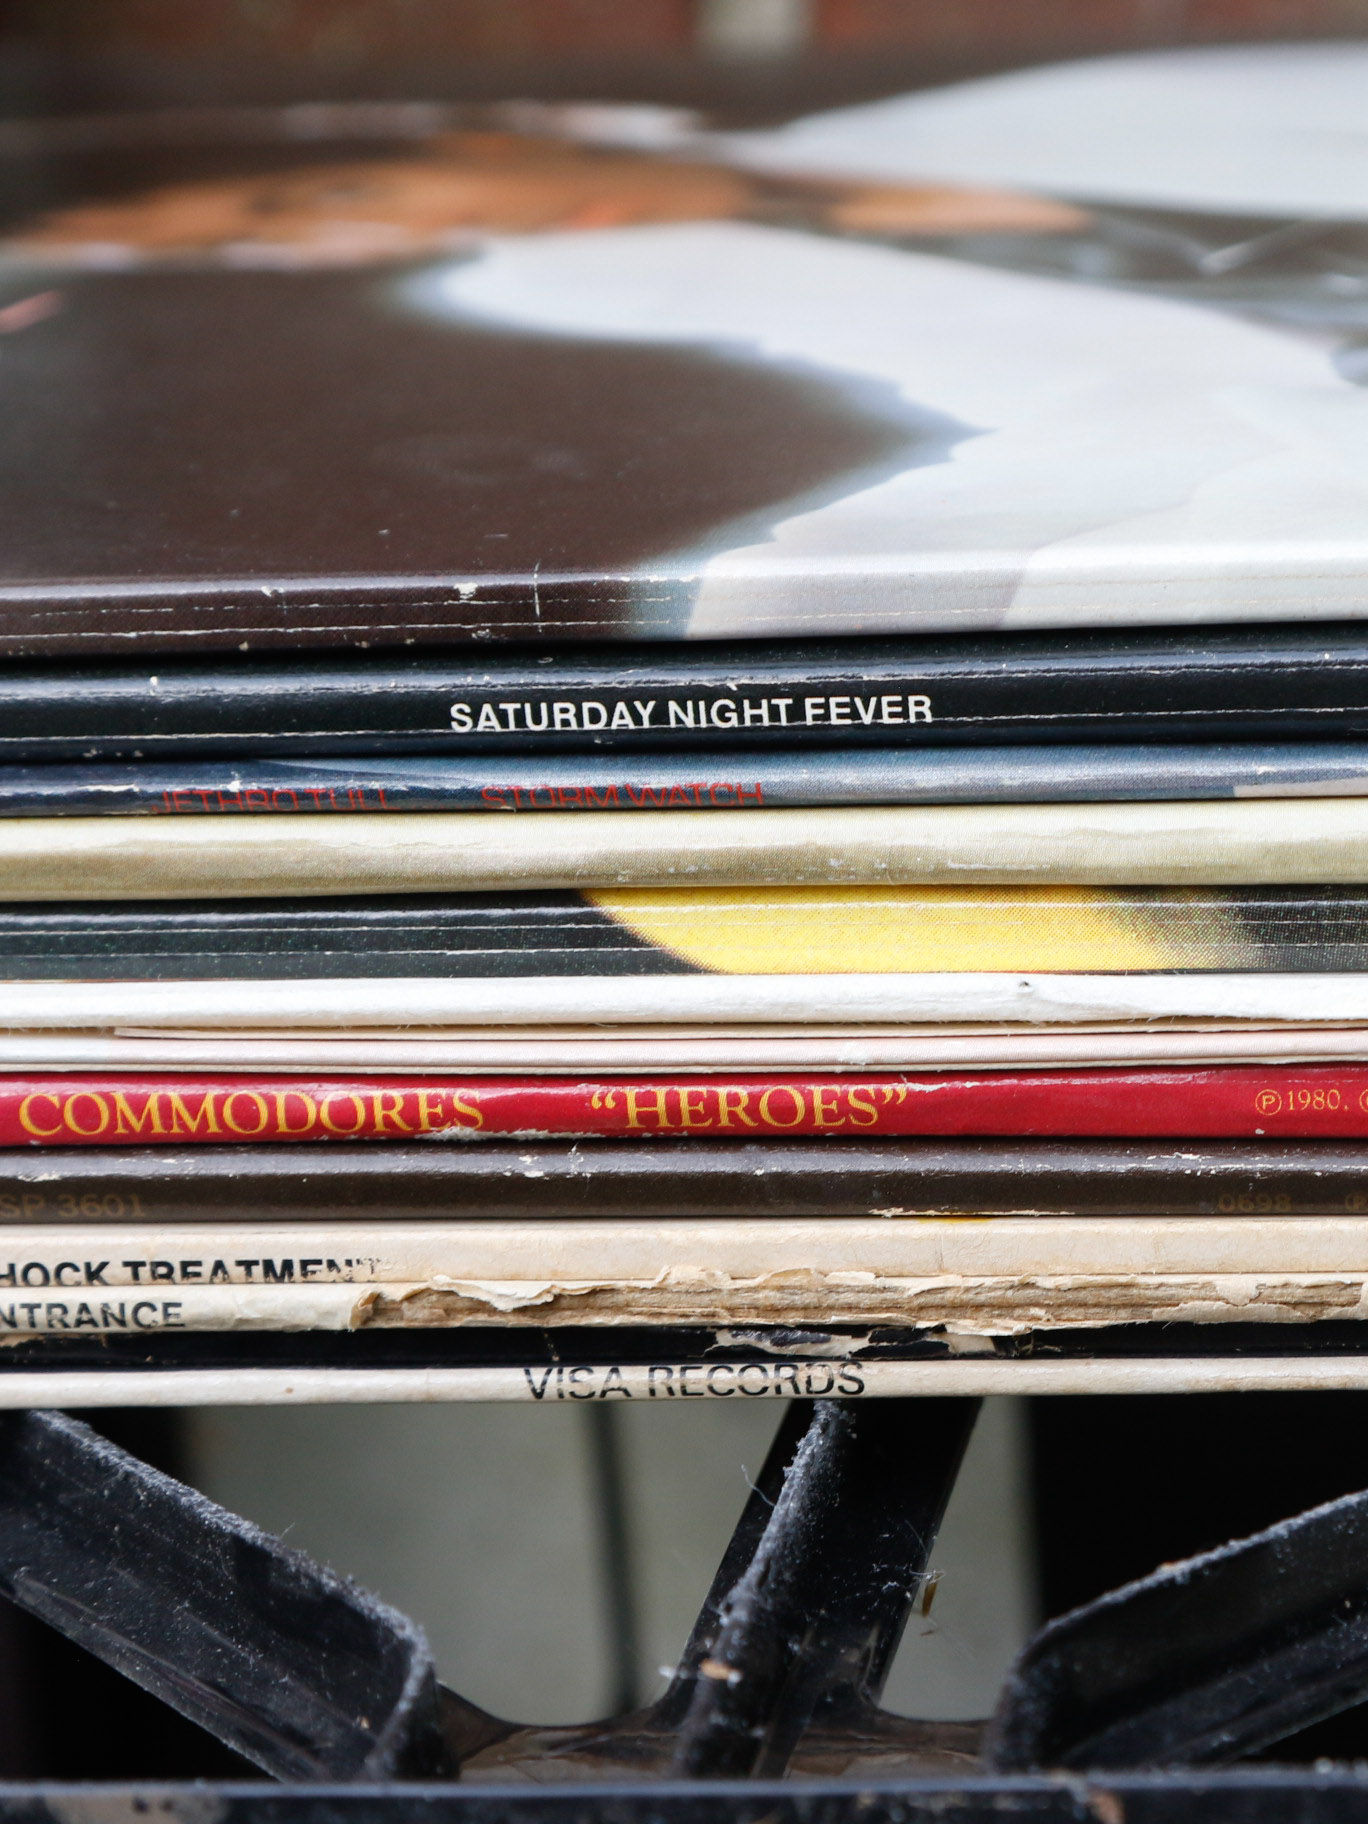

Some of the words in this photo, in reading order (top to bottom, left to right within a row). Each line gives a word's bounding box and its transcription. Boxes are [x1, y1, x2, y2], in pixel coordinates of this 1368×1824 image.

[449, 700, 656, 733] SATURDAY
[668, 697, 793, 729] NIGHT
[804, 694, 934, 727] FEVER
[151, 789, 300, 814] JETHRO
[304, 788, 401, 811] TULL
[18, 1088, 485, 1137] COMMODORES
[57, 1192, 146, 1217] 3601
[522, 1366, 633, 1400] VISA
[646, 1360, 866, 1399] RECORDS
